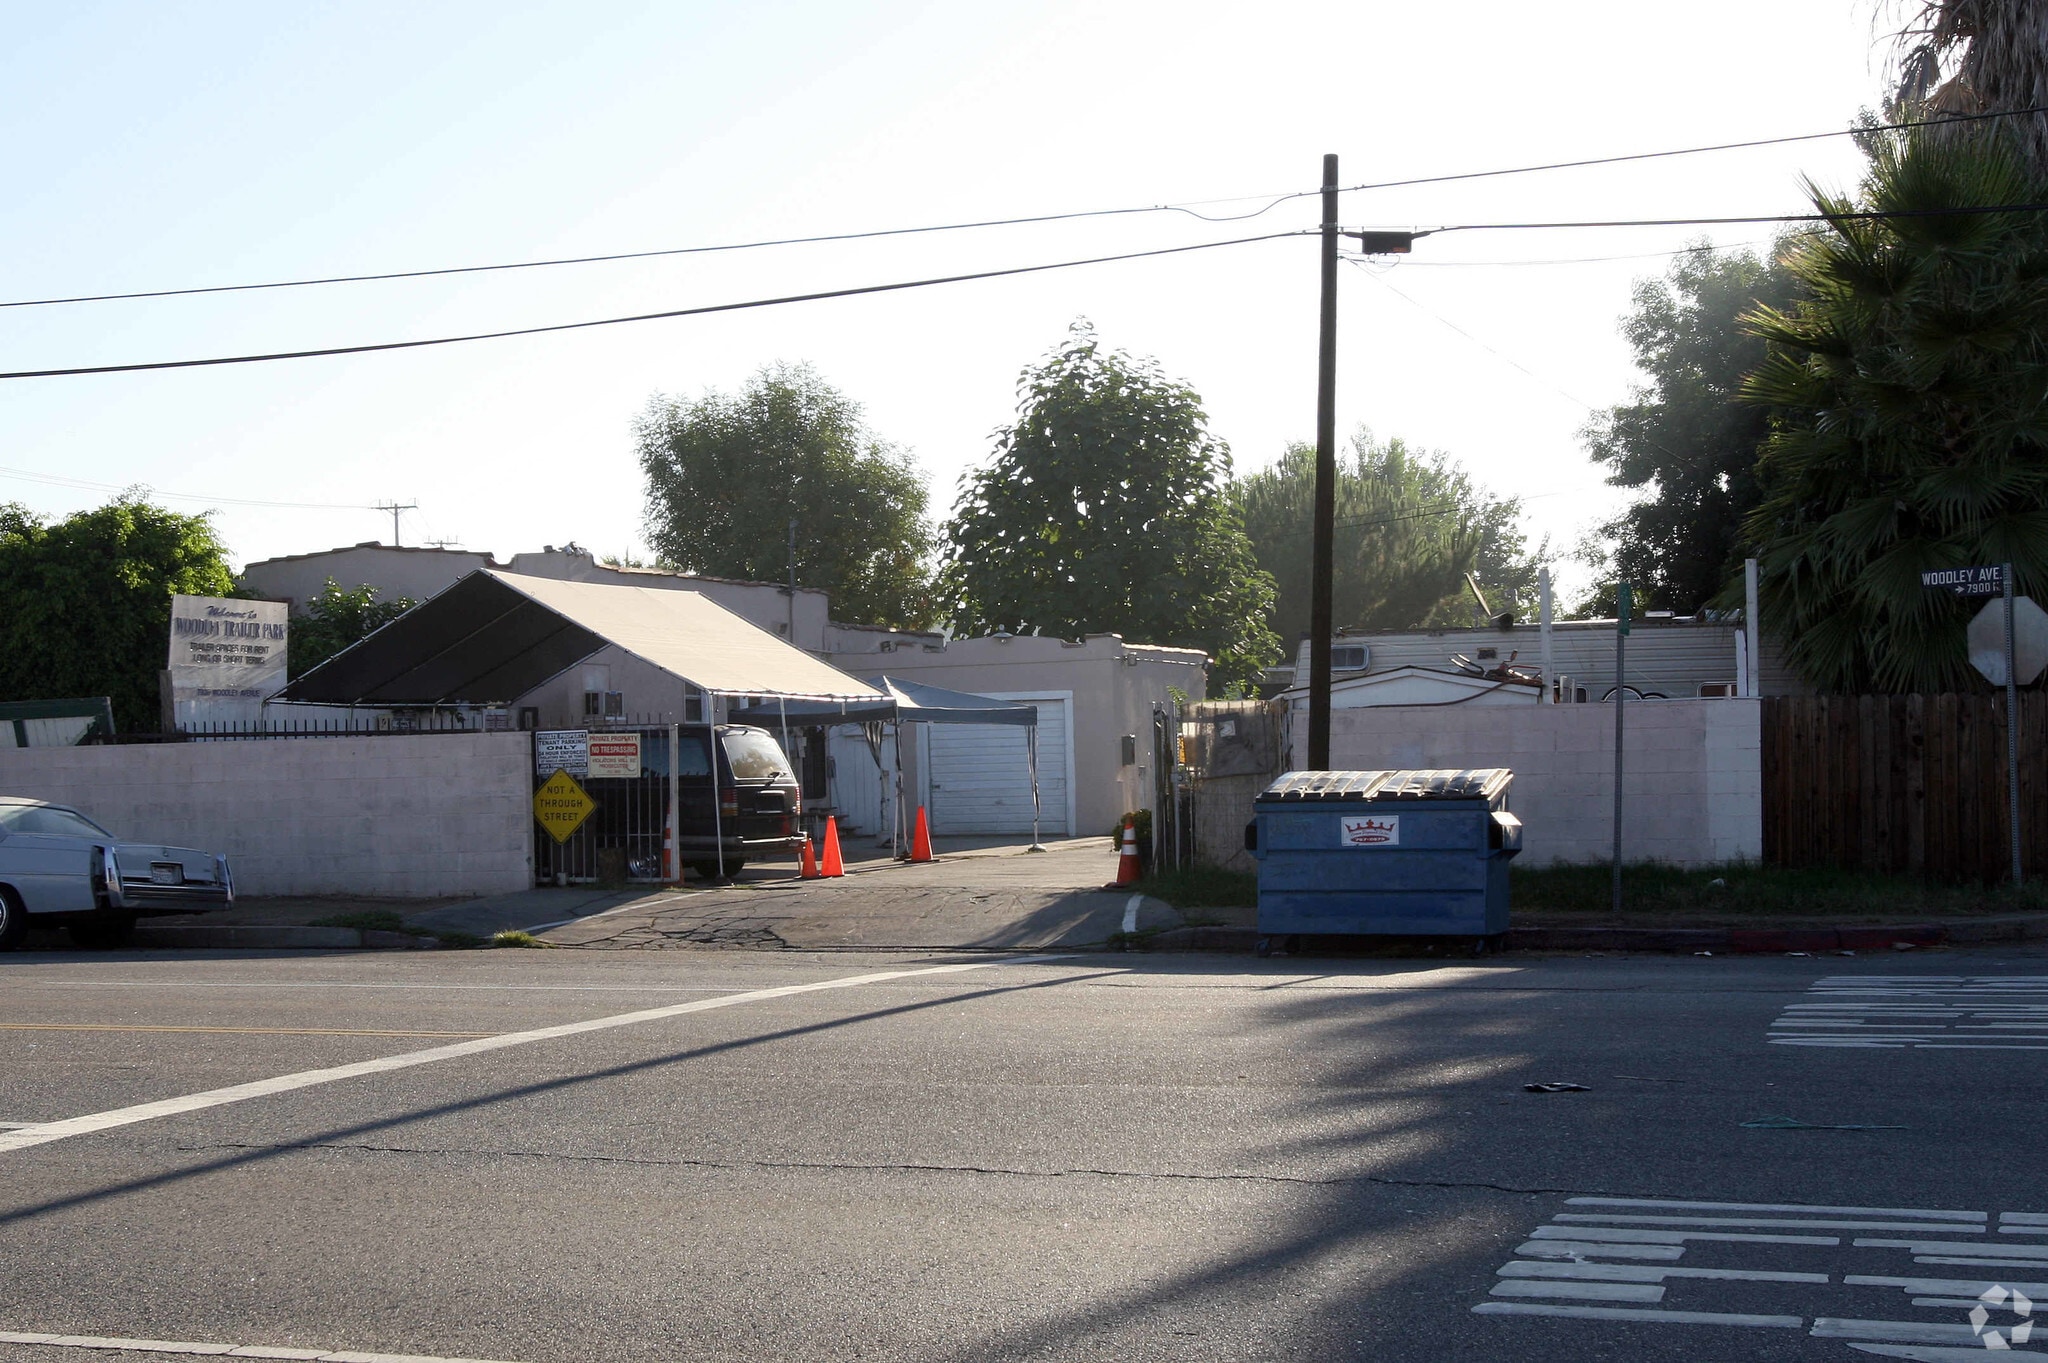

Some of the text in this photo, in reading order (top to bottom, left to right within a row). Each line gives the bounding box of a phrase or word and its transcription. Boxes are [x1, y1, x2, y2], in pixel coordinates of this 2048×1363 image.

[1922, 567, 2003, 586] WOODLEY AVE.
[1967, 582, 1991, 593] 7900
[205, 605, 247, 618] Welcome
[223, 620, 261, 639] TRAILER
[263, 623, 285, 640] PARK
[189, 642, 270, 654] TRAILER SPACES FOR RENT
[193, 654, 211, 663] LONG
[212, 655, 222, 663] OR
[223, 655, 243, 663] SHORT
[212, 689, 238, 697] WOODLEY
[240, 689, 260, 697] AVENUE
[601, 745, 636, 753] TRESPASSING
[546, 786, 575, 794] NOT A
[540, 799, 583, 808] THROUGH
[544, 812, 578, 820] STREET
